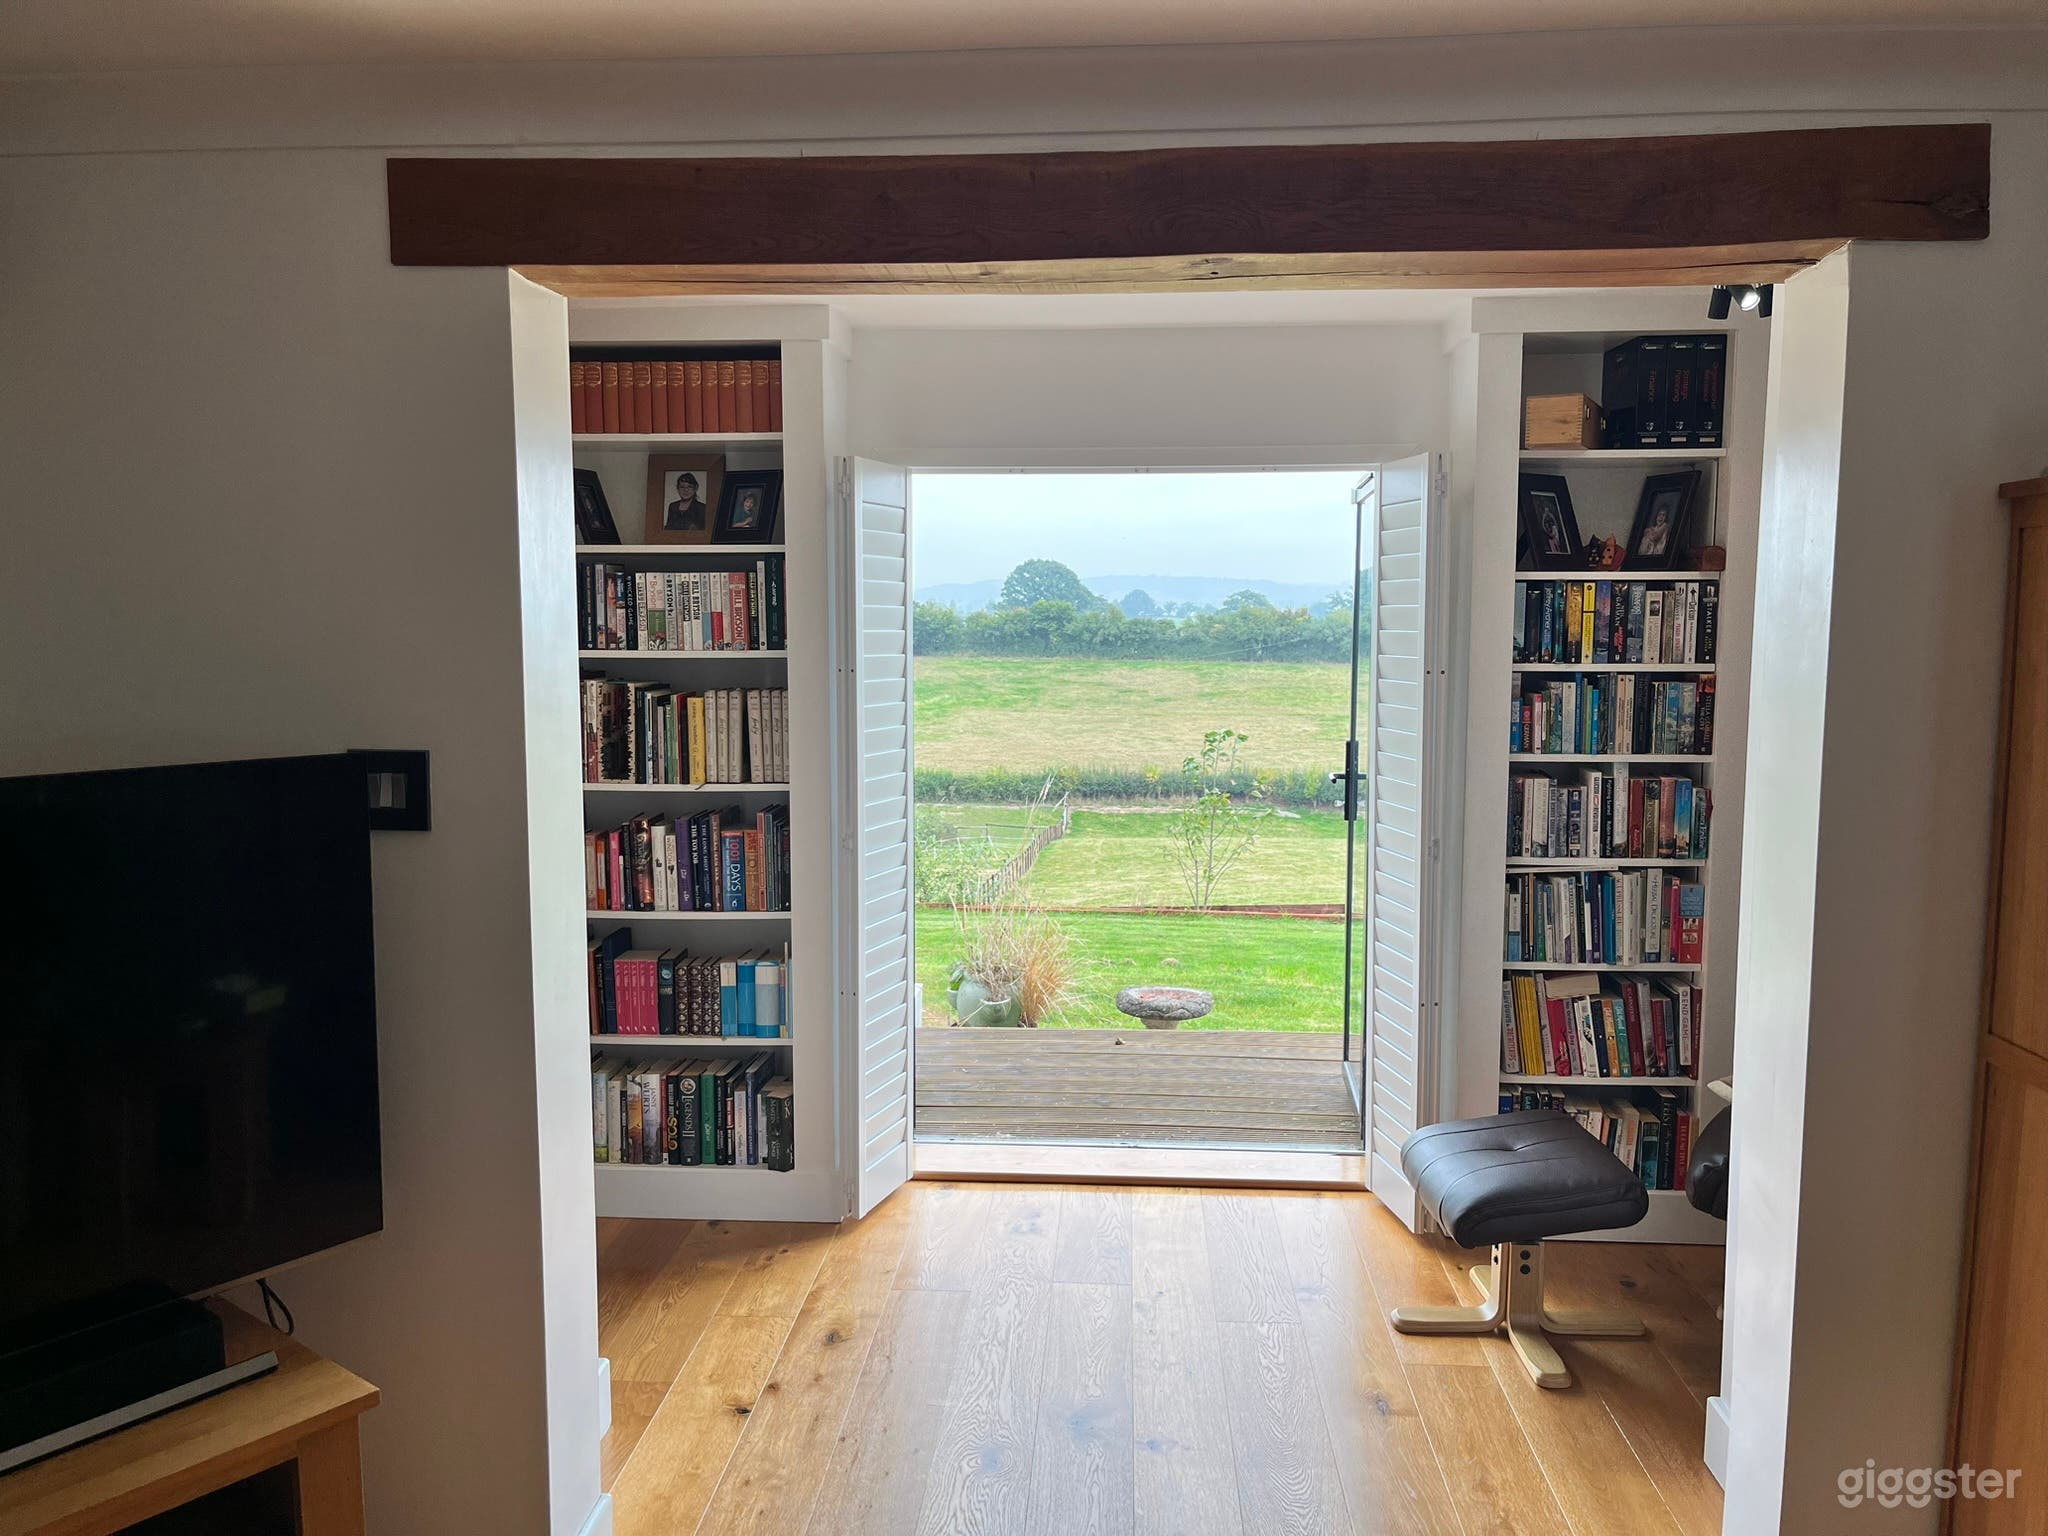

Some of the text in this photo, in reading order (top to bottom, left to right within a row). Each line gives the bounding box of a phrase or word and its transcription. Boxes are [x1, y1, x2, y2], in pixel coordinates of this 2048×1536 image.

[692, 581, 700, 620] BILL BRYSON
[734, 590, 743, 638] BILL BRYSON
[1544, 587, 1553, 608] Jeffrey
[730, 838, 741, 891] 1001 DAYS
[682, 1095, 695, 1130] LEGENDS
[1663, 1102, 1673, 1126] FEIST
[667, 1117, 678, 1150] SOLO
